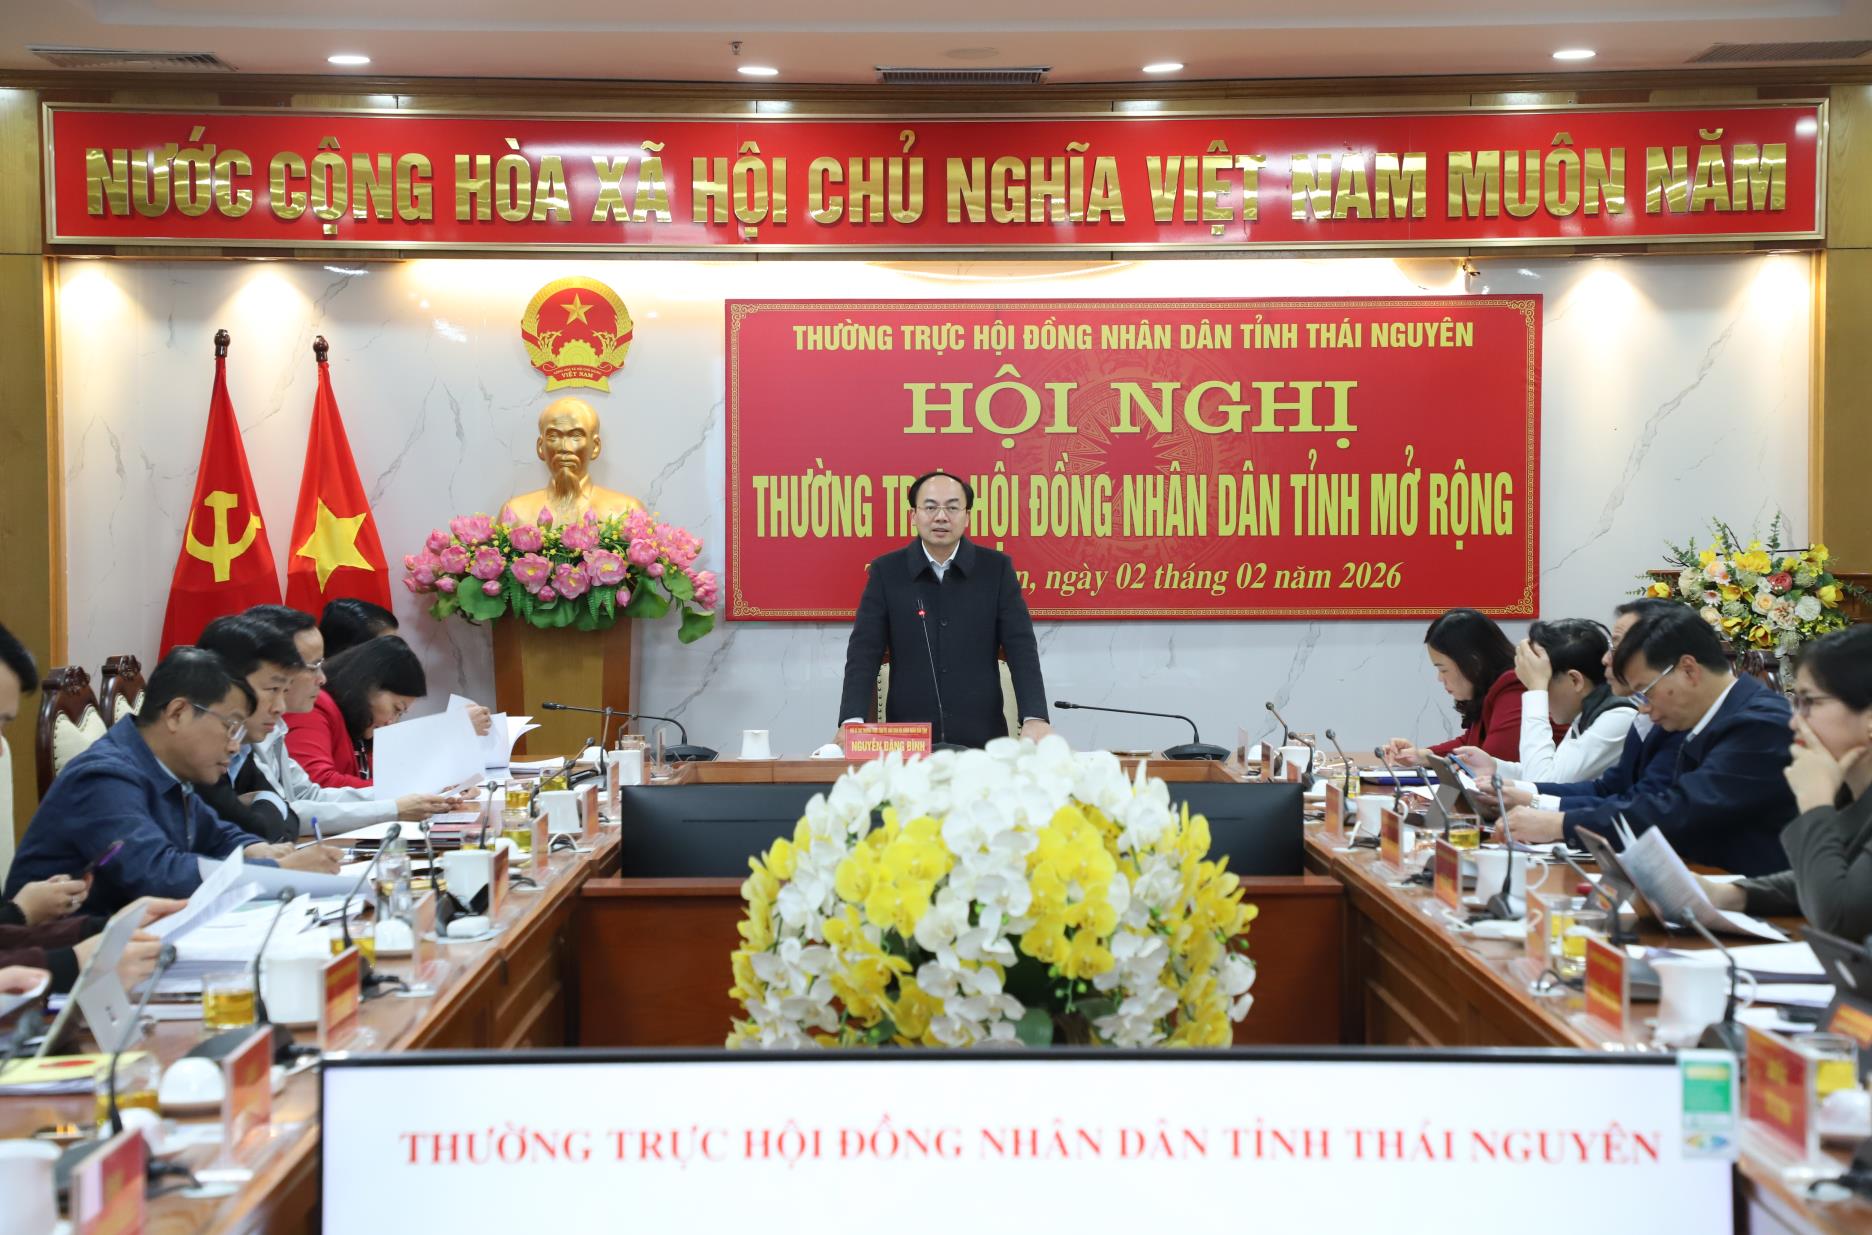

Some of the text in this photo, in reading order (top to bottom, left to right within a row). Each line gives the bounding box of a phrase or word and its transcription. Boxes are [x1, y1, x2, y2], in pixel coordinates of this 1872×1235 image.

[86, 126, 1787, 238] NƯỚC CỘNG HÒA XÃ HỘI CHỦ NGHĨA VIỆT NAM MUÔN NĂM
[793, 314, 1474, 355] THƯỜNG TRỰC HỘI ĐỒNG NHÂN DÂN TỈNH THÁI NGUYÊN
[903, 363, 1358, 449] HỘI NGHỊ
[752, 458, 873, 538] THƯỜNG
[970, 461, 1019, 552] HỘI
[1028, 452, 1112, 538] ĐỒNG
[1123, 461, 1208, 537] NHÂN
[1218, 460, 1280, 537] DÂN
[1290, 449, 1360, 536] TỈNH
[1370, 445, 1421, 536] MỞ
[1429, 459, 1513, 550] RỘNG
[1045, 563, 1108, 597] ngày
[1115, 562, 1147, 589] 02
[1154, 563, 1229, 596] tháng
[1236, 562, 1268, 589] 02
[1274, 566, 1332, 589] năm
[1339, 561, 1404, 589] 2026
[401, 1113, 1662, 1169] THƯỜNG TRỰC HỘI ĐỒNG NHÂN DÂN TỈNH THÁI NGUYÊN
